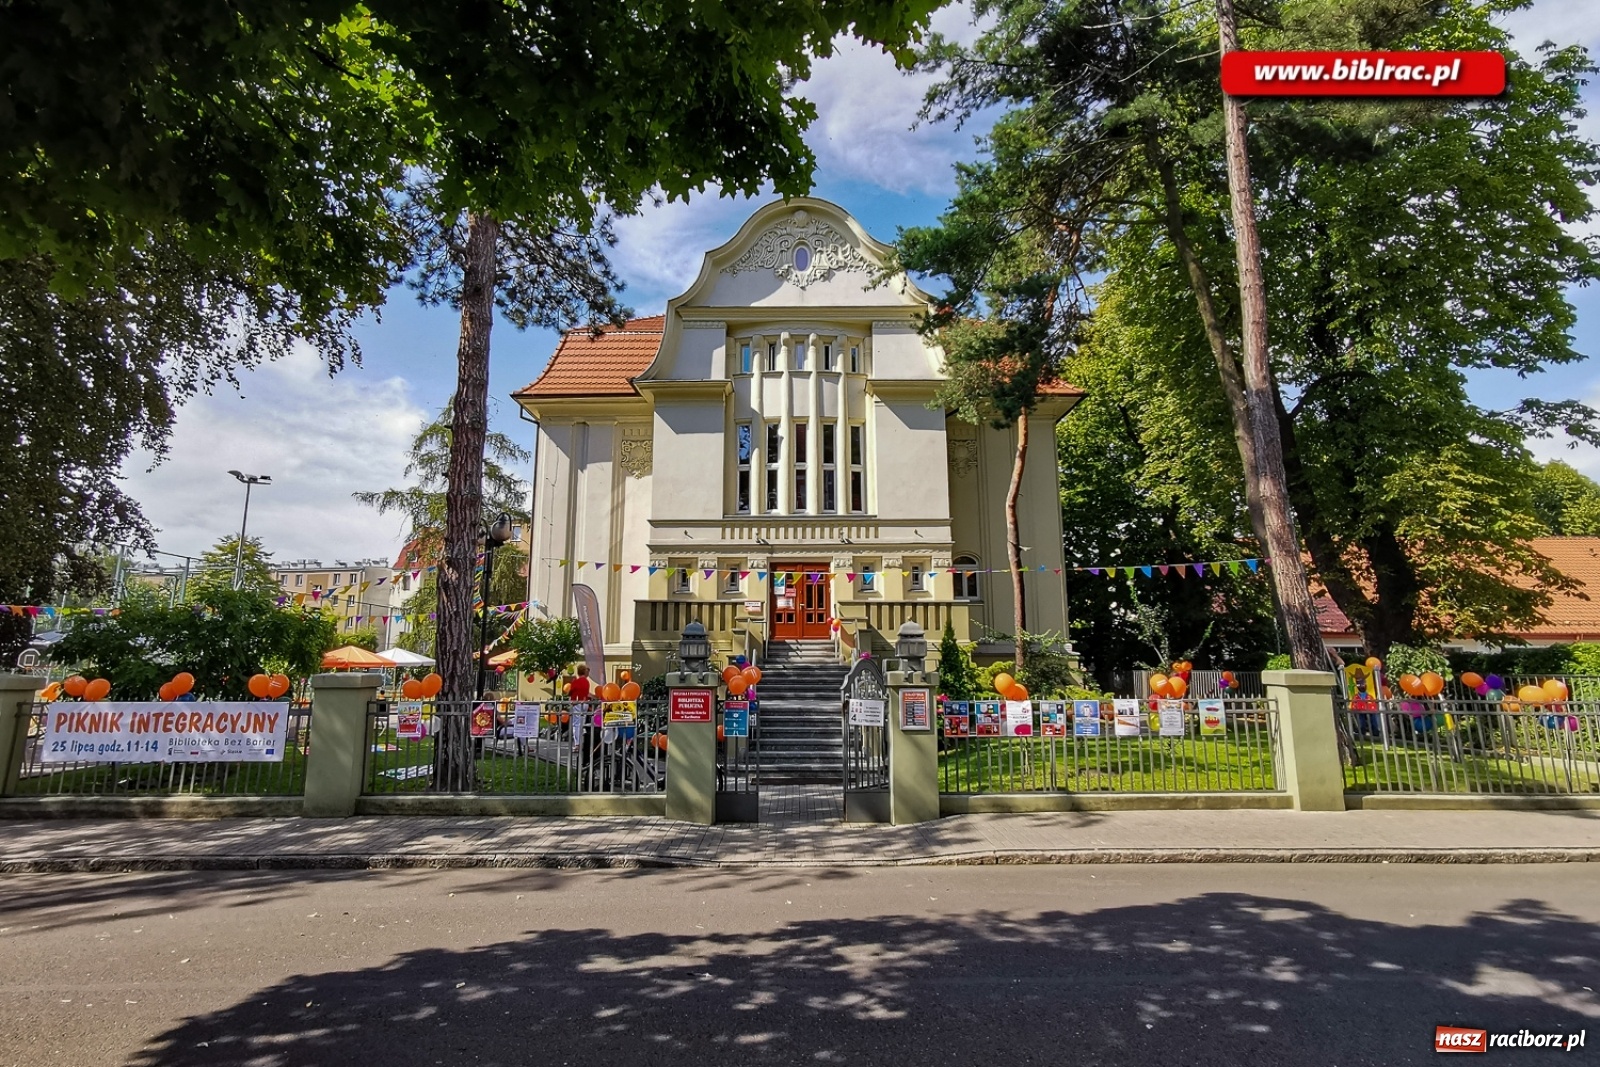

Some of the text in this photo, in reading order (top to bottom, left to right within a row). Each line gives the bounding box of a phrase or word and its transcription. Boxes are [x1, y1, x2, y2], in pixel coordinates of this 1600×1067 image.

[55, 711, 124, 734] PIKNIK
[51, 740, 67, 752] 25
[70, 740, 95, 755] lipca
[98, 740, 125, 755] godz.
[126, 740, 159, 753] 11-14
[168, 738, 276, 747] Biblioteka Bez Barier
